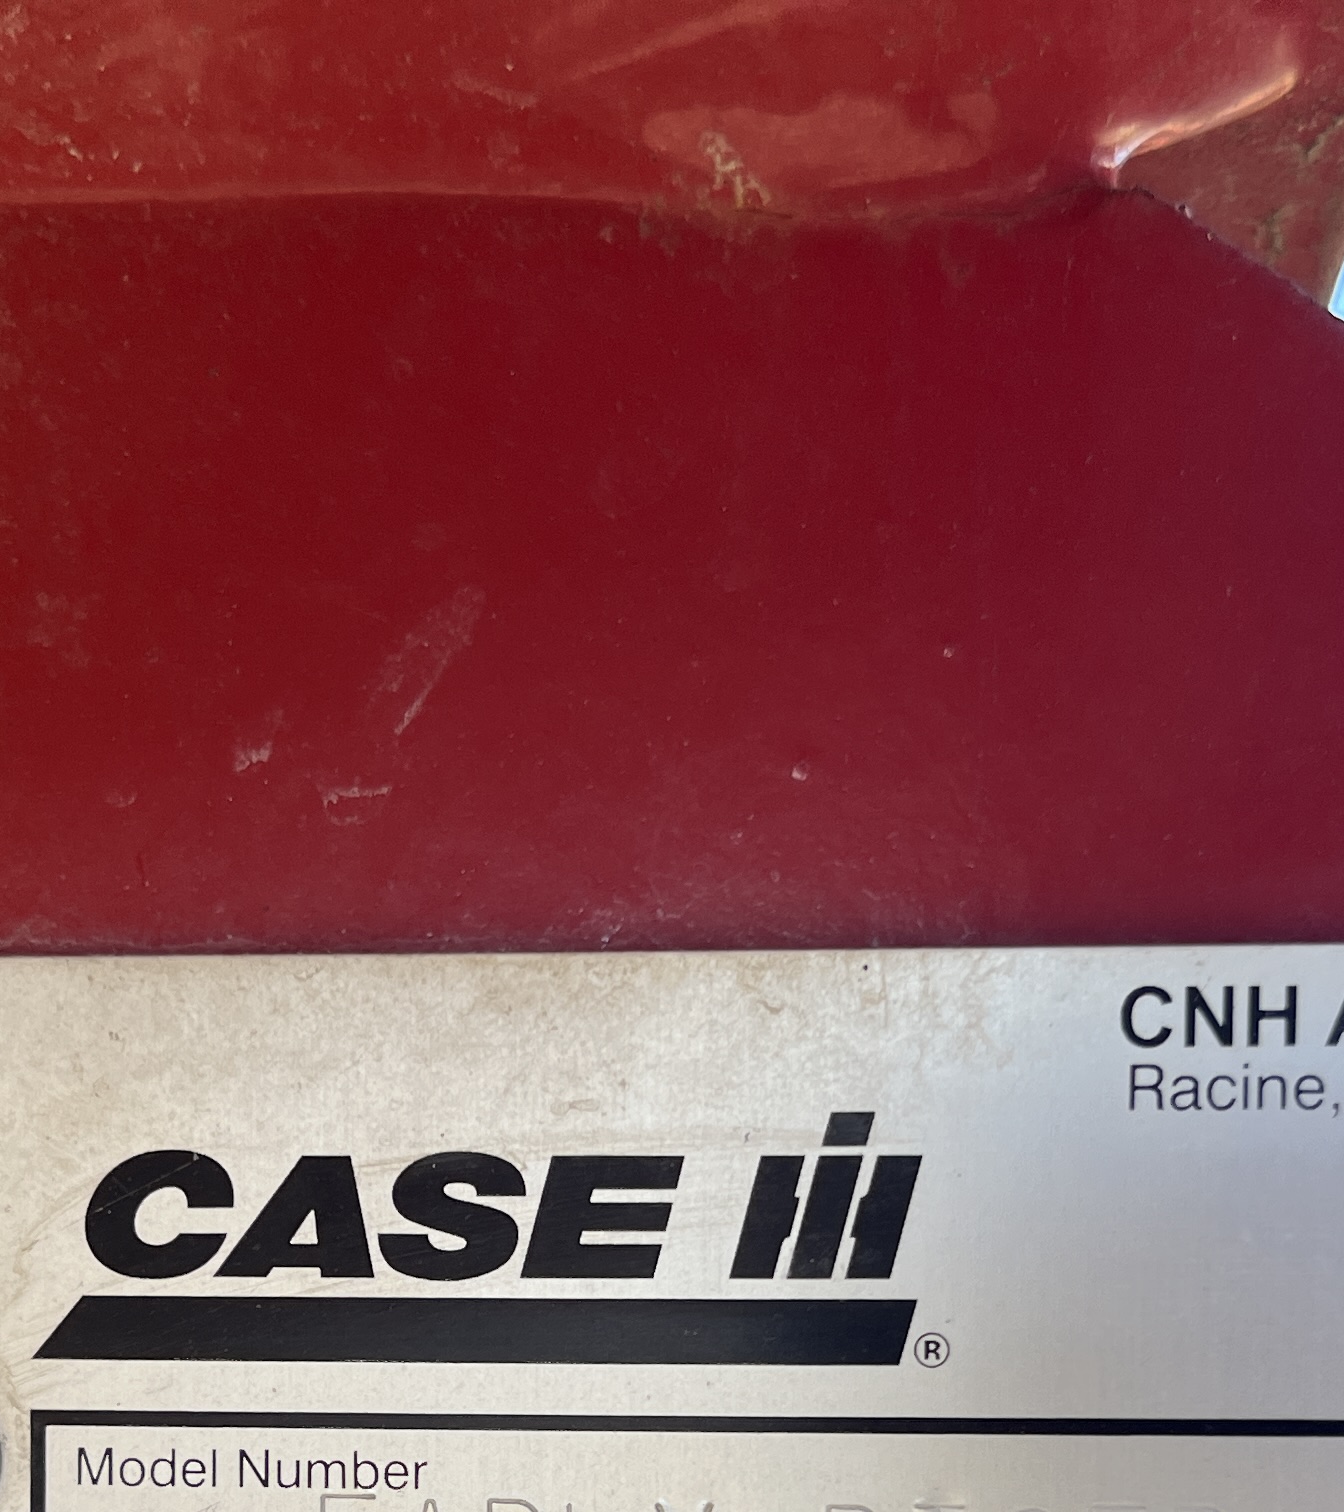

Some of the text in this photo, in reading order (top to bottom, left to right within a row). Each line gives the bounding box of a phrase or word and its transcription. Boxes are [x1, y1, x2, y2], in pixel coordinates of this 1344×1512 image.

[1119, 984, 1300, 1049] CNH
[1127, 1062, 1342, 1118] Racine,
[83, 1148, 686, 1282] CASE
[76, 1446, 429, 1492] Model Number
